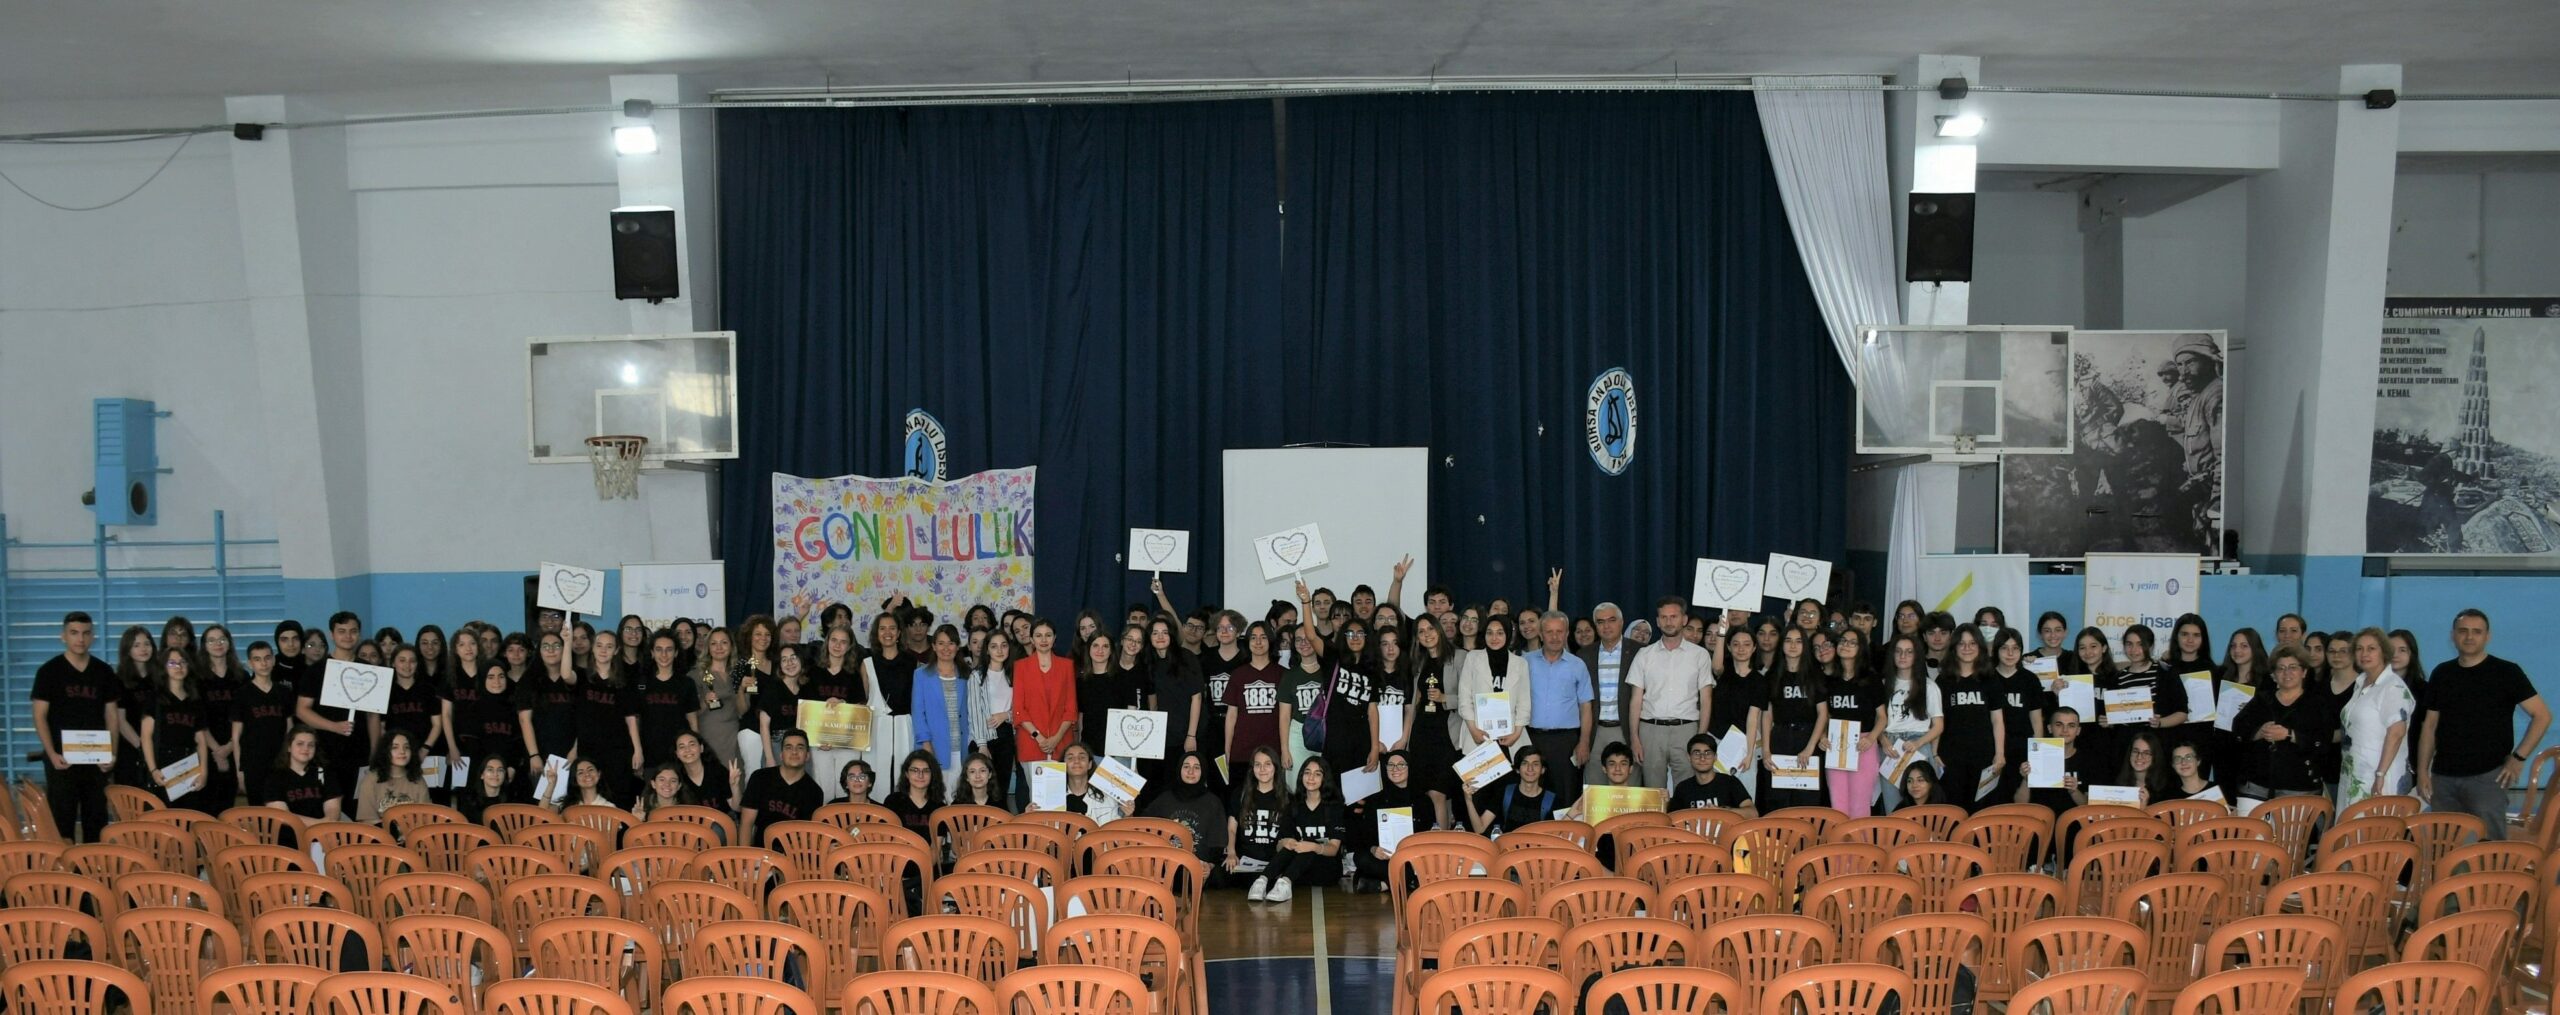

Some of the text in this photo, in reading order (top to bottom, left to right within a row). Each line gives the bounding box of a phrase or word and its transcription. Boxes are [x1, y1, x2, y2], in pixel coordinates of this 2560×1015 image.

[2486, 307, 2532, 318] KAZANDIK
[1242, 687, 1277, 707] 1883
[1784, 685, 1808, 699] BAL
[1957, 690, 1986, 706] BAL
[2007, 692, 2024, 708] AL
[1833, 694, 1859, 709] BAL
[767, 799, 798, 820] SSAL
